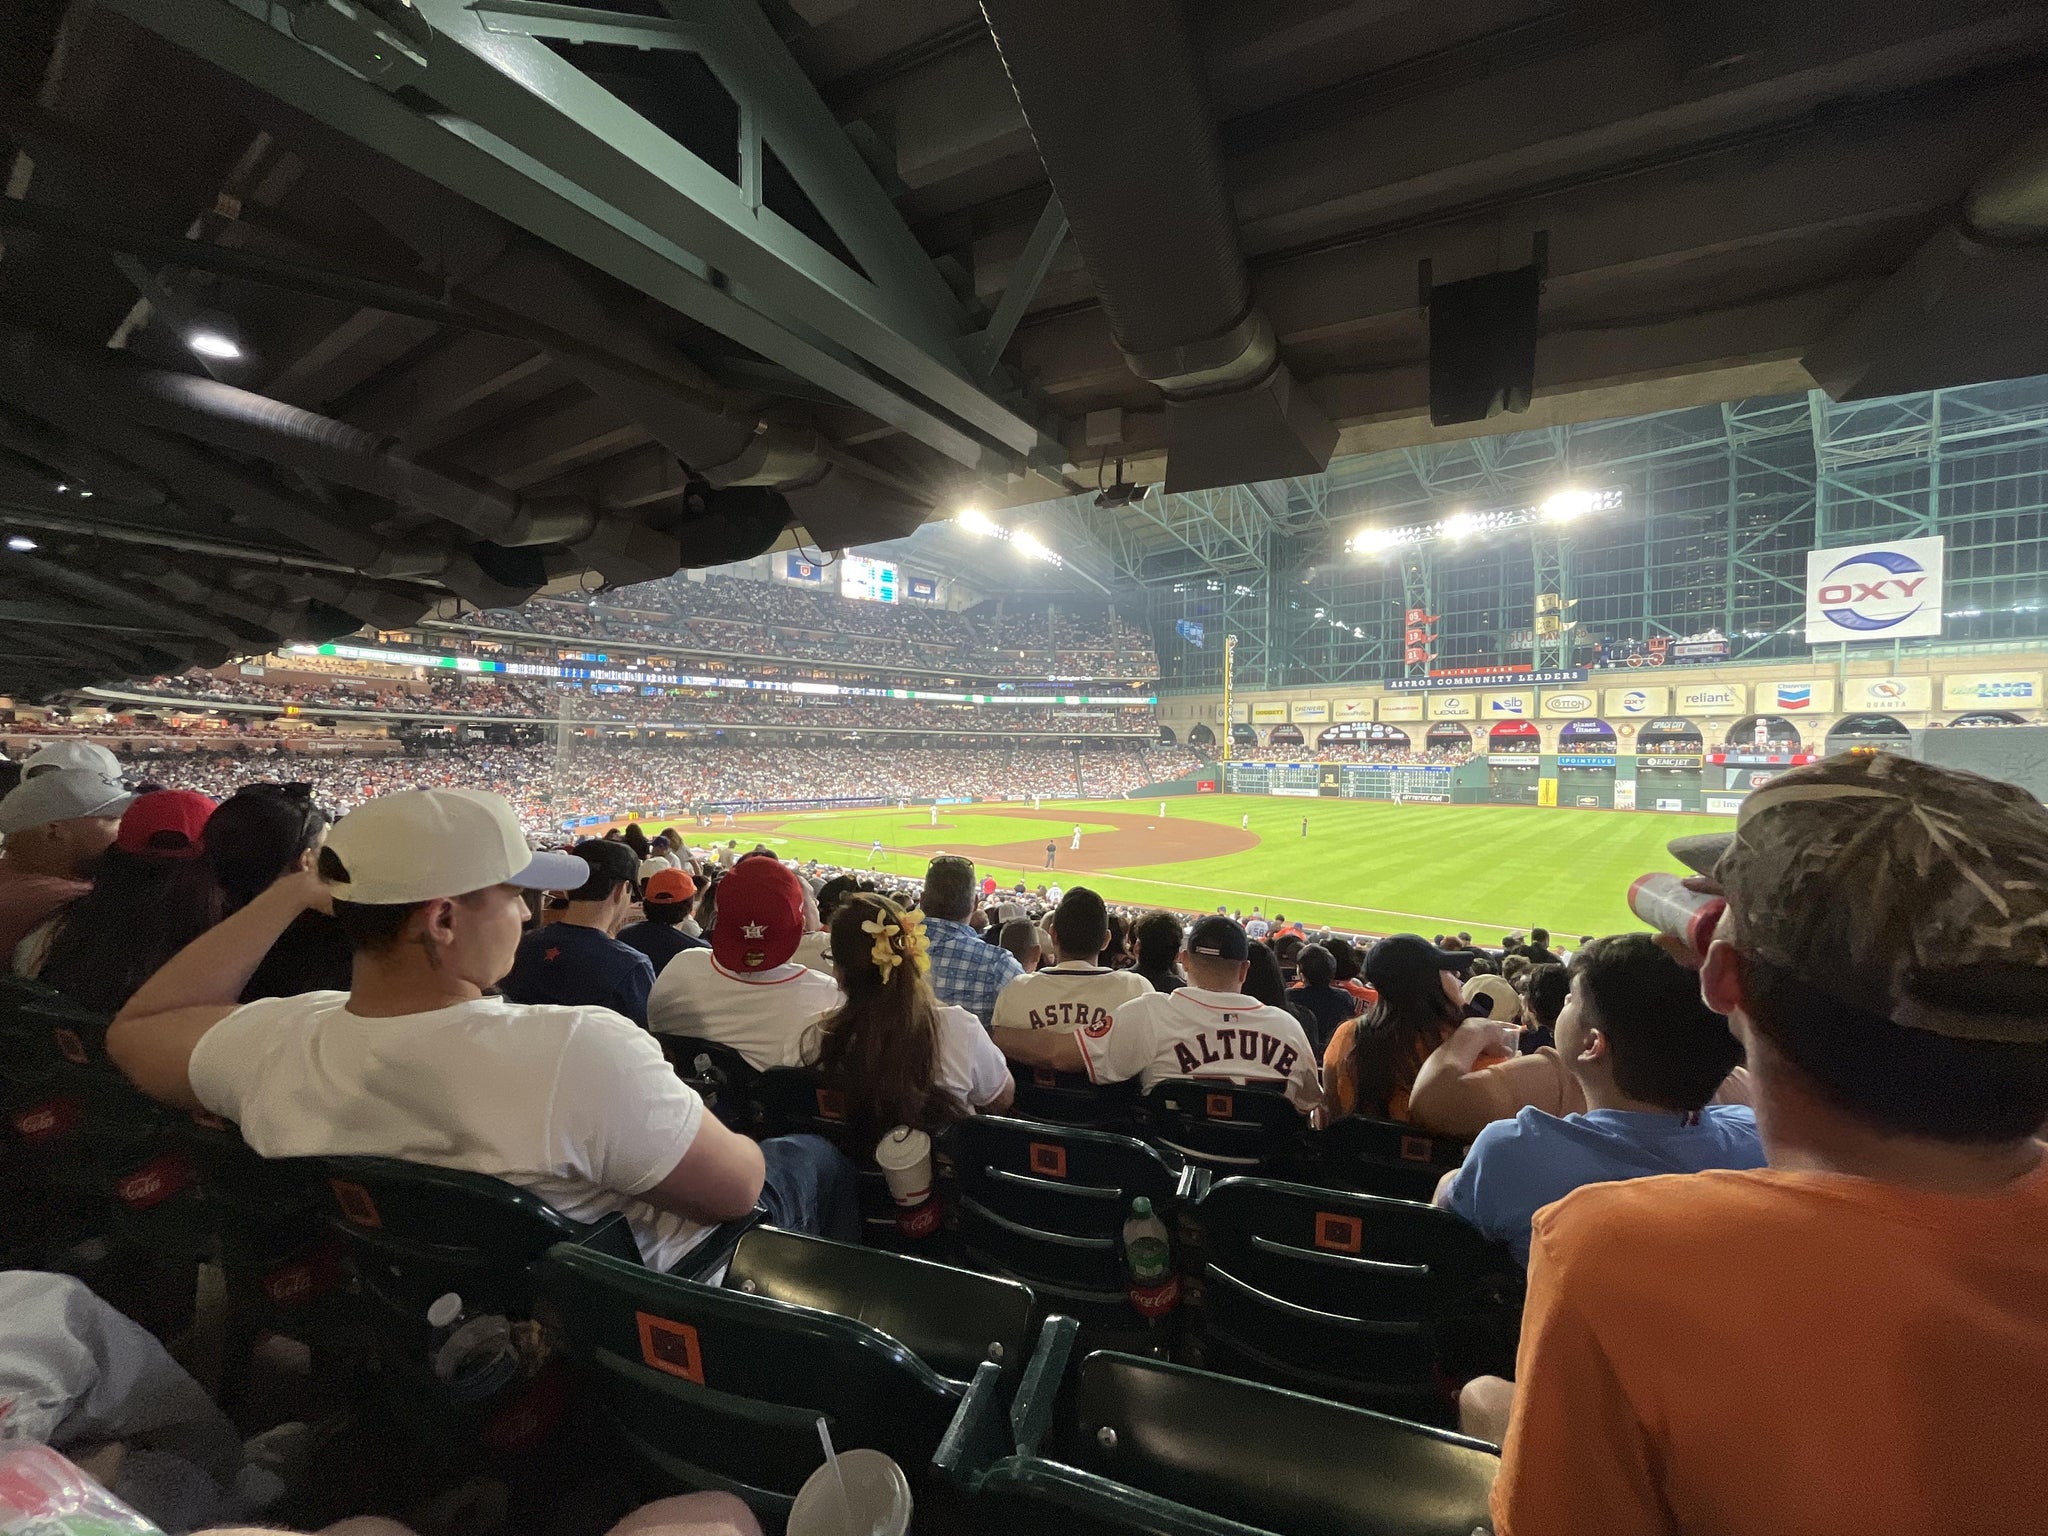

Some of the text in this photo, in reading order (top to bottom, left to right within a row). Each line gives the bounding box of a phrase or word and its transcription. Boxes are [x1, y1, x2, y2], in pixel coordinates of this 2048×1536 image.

[1818, 577, 1927, 605] OXY
[1409, 612, 1419, 621] 05
[1409, 632, 1419, 641] 19
[1408, 651, 1417, 659] 21
[1391, 671, 1579, 688] ASTROS COMMUNITY LEADERS
[1504, 697, 1523, 707] slb
[1686, 692, 1730, 704] reliant
[1656, 758, 1690, 766] EMCJET
[1253, 928, 1265, 937] 58
[1029, 1002, 1107, 1029] ASTRO
[1174, 1028, 1299, 1078] ALTUVE
